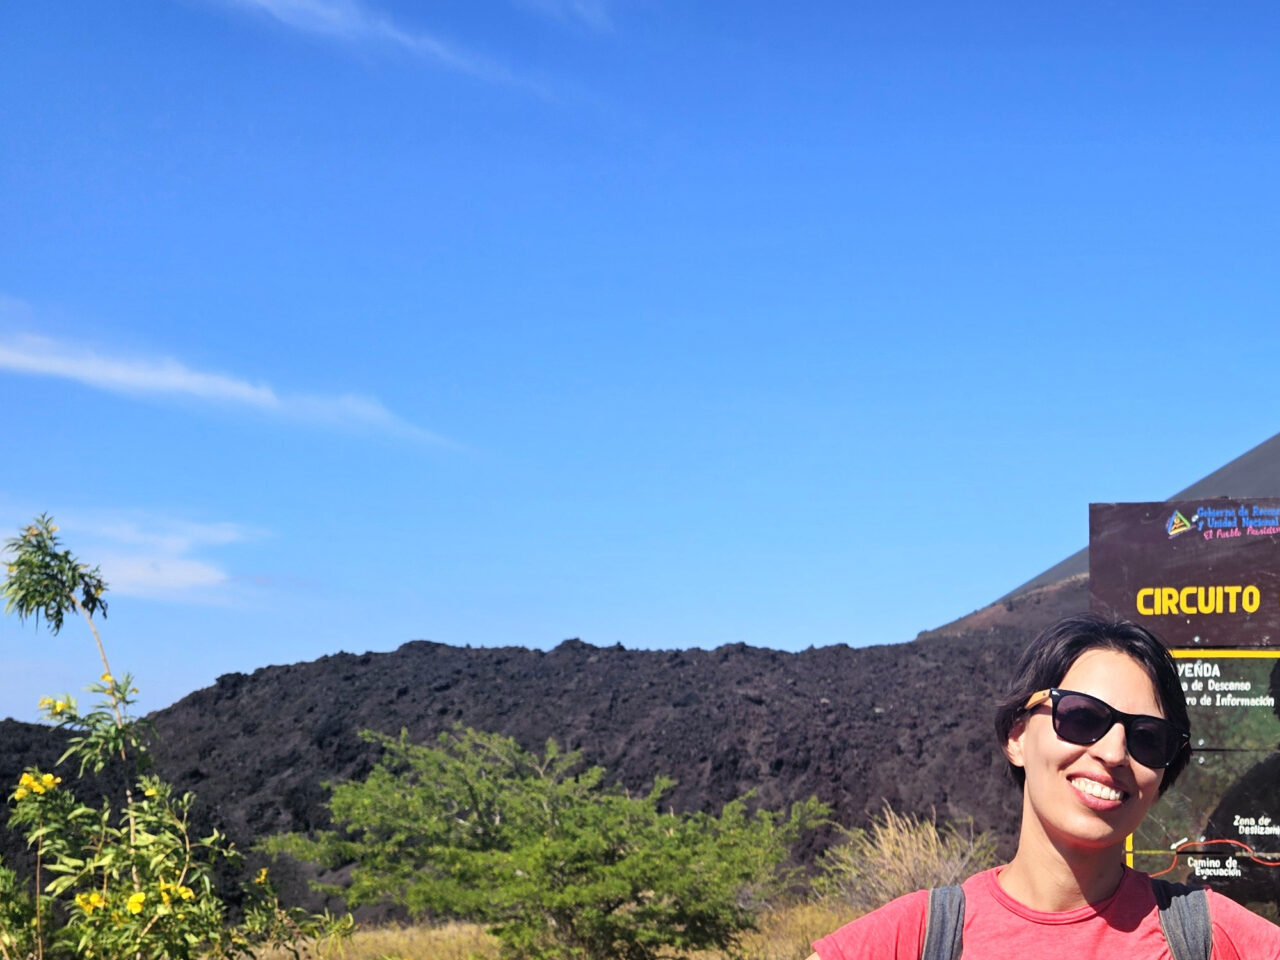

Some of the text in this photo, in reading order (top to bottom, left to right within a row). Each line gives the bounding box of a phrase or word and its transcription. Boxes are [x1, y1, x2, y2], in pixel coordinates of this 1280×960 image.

[1208, 517, 1237, 528] Unidad
[1242, 517, 1279, 527] Nacional
[1204, 530, 1213, 541] El
[1136, 585, 1260, 615] CIRCUITO
[1177, 663, 1221, 678] YENDA
[1191, 680, 1203, 691] de
[1208, 679, 1251, 692] Descanso
[1200, 694, 1212, 706] de
[1216, 693, 1275, 707] Información
[1233, 815, 1270, 826] Zona de
[1187, 856, 1238, 869] Camino de
